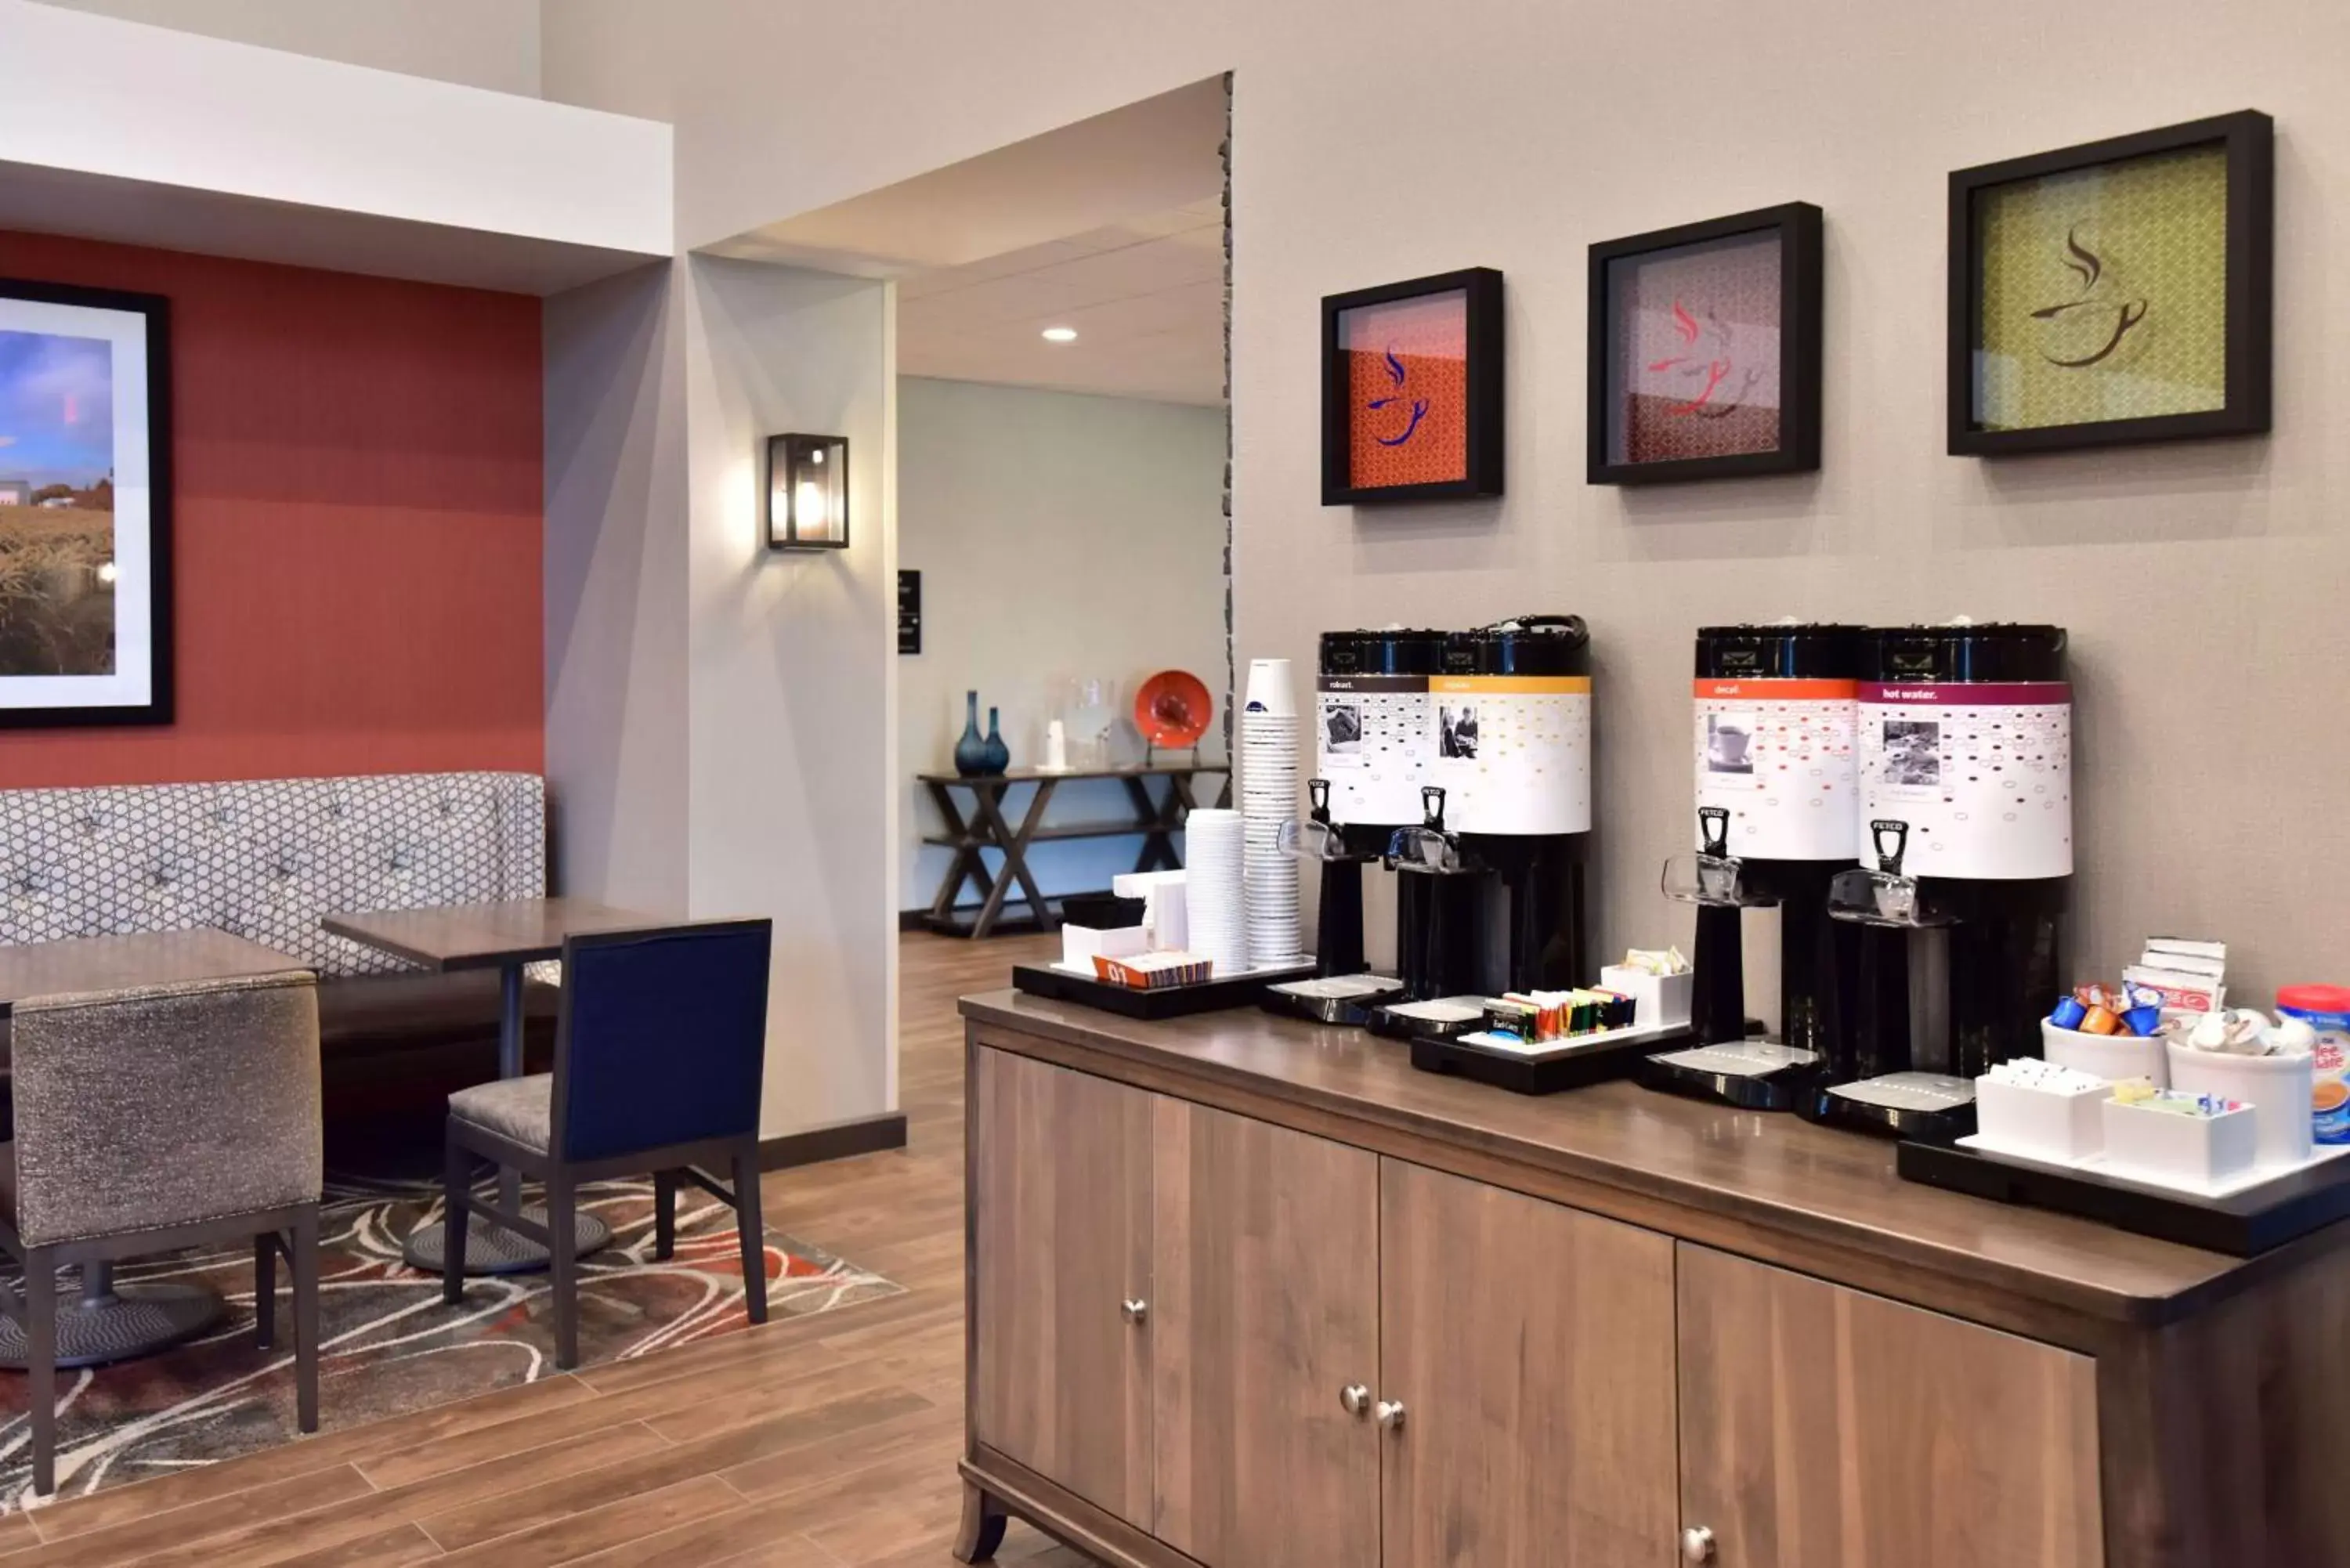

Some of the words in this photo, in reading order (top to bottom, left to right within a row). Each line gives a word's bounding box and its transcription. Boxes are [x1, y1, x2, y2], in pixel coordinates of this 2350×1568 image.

[1882, 688, 1900, 699] hot
[1901, 689, 1939, 700] water.
[1700, 808, 1724, 817] FETCO
[1873, 822, 1904, 831] FETCO
